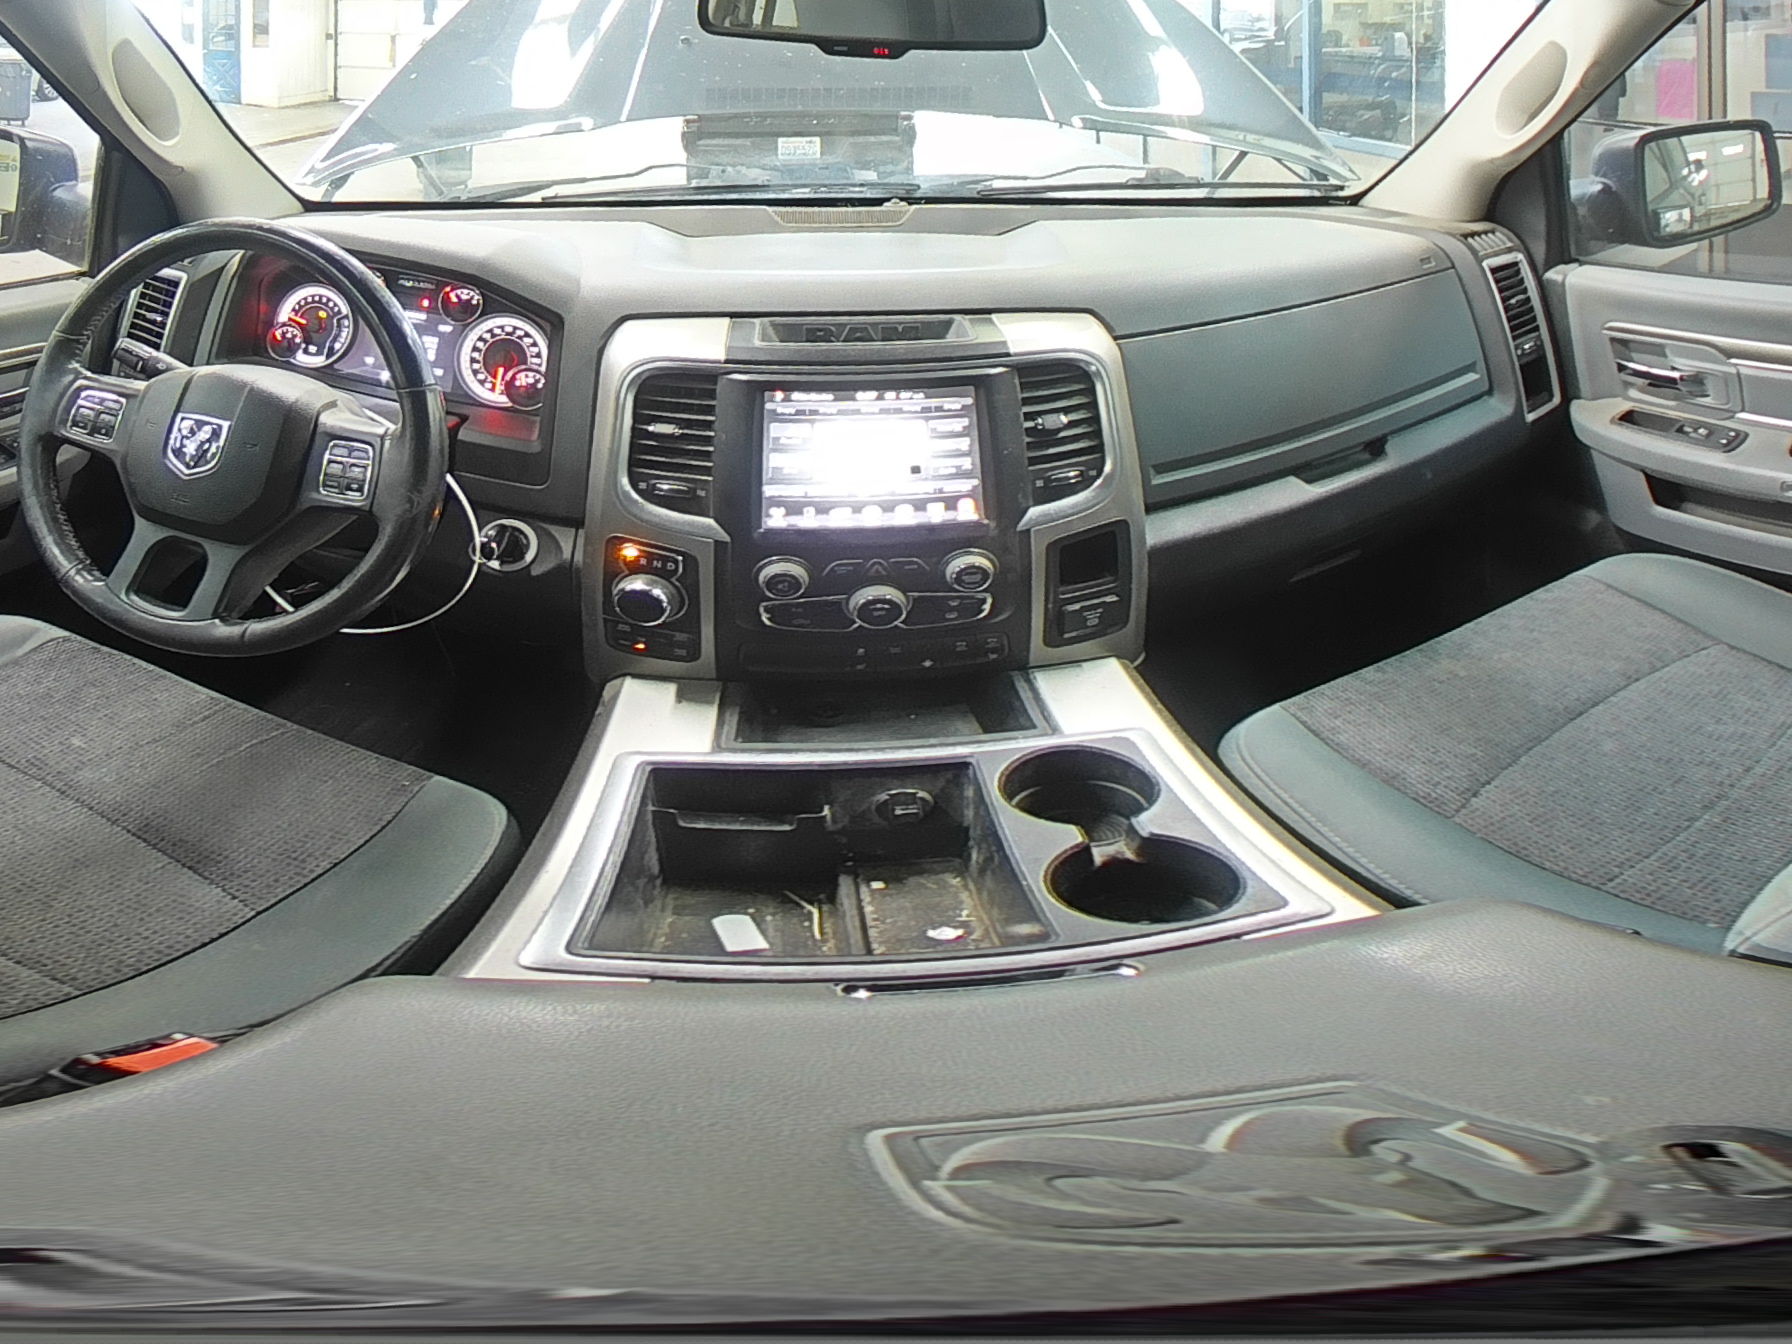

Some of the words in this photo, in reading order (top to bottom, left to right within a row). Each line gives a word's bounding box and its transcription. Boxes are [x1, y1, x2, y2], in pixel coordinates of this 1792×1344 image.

[803, 324, 921, 343] RAM
[639, 557, 648, 566] R
[653, 559, 662, 568] N
[666, 562, 676, 570] D
